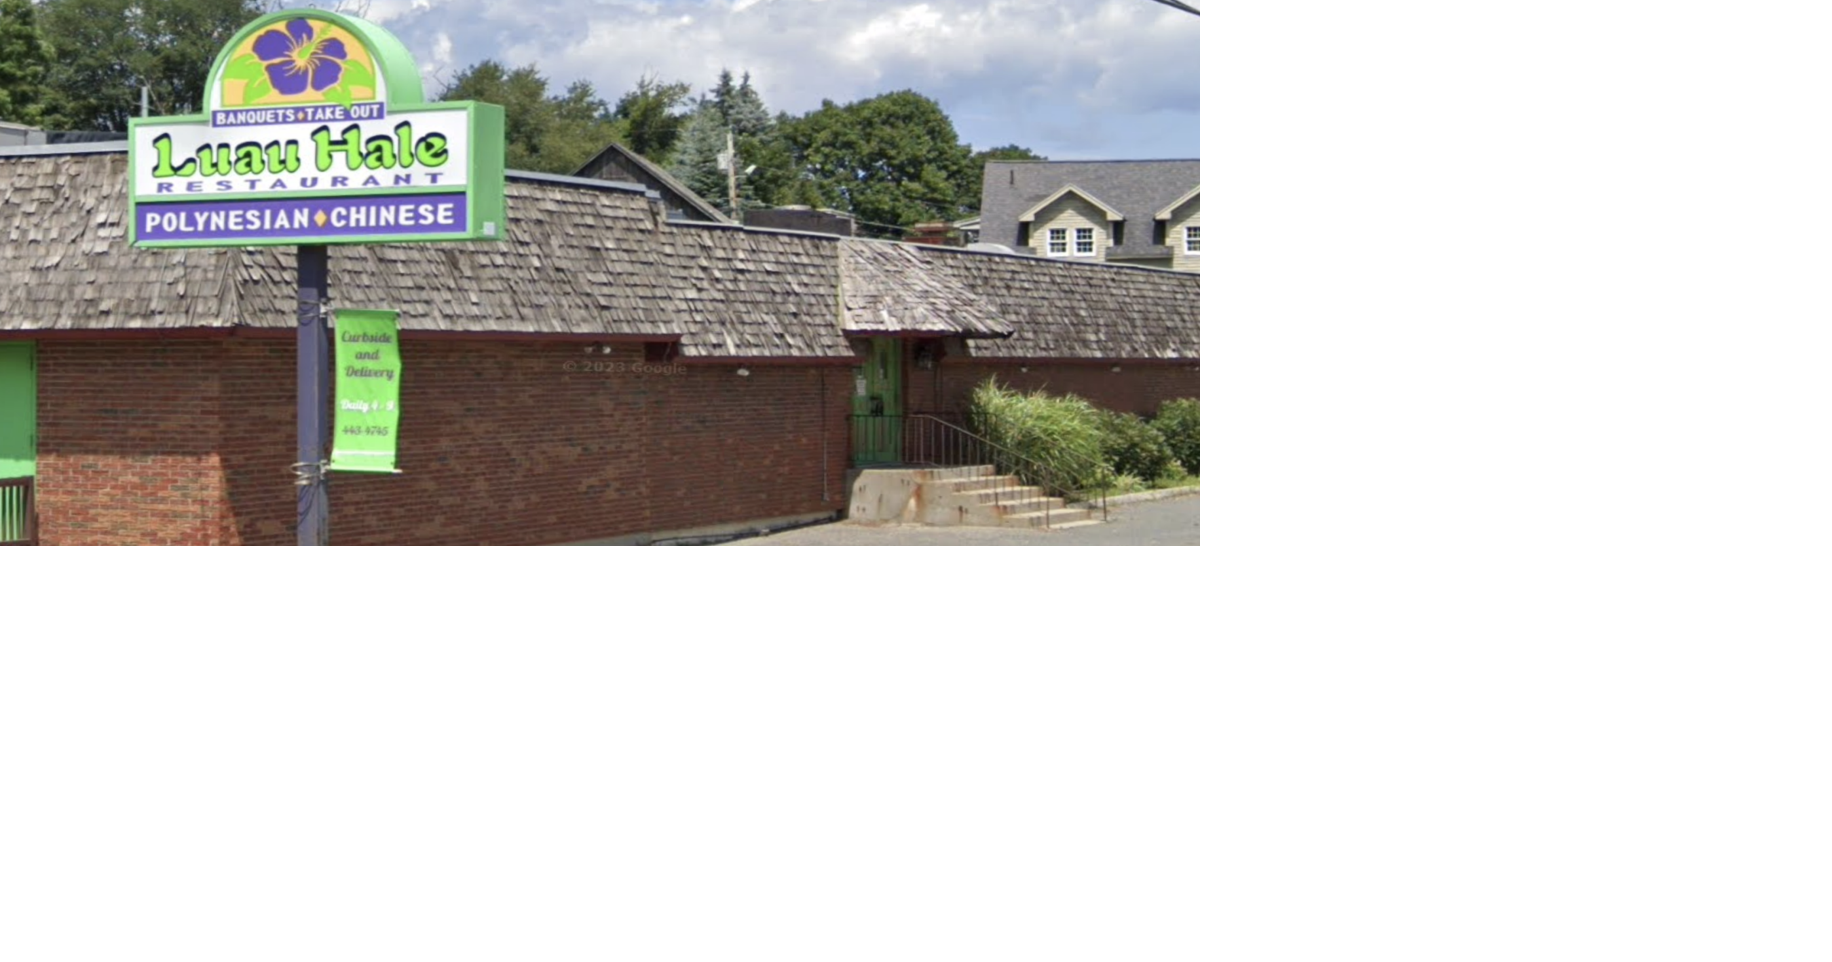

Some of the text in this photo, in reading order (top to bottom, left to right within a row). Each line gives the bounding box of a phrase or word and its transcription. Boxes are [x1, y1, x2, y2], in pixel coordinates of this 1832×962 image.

[215, 104, 381, 125] BANQUETS TAKE OUT
[152, 120, 449, 178] Luau Hale
[156, 172, 444, 194] RESTAURANT
[145, 203, 454, 233] POLYNESIAN CHINESE
[341, 331, 393, 344] Curbside
[355, 349, 381, 360] and
[344, 366, 394, 381] Delivery
[340, 399, 369, 413] Daily
